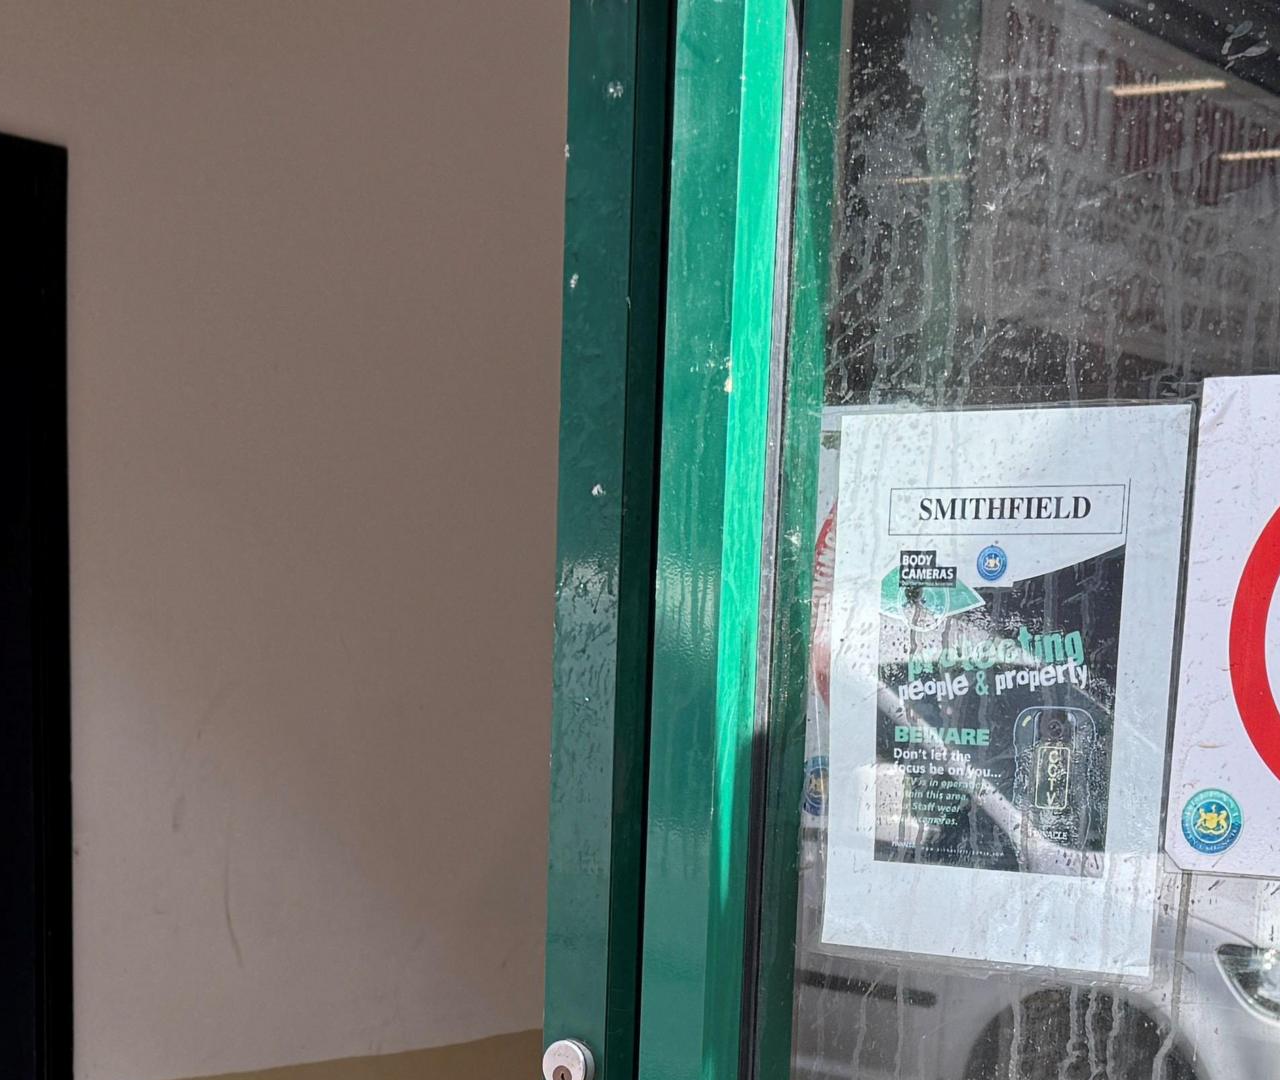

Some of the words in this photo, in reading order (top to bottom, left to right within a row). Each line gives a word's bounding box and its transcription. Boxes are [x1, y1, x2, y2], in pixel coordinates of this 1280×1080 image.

[919, 496, 1092, 521] SMITHFIELD
[902, 554, 933, 566] BODY
[901, 568, 954, 580] CAMERAS
[908, 626, 1085, 681] protecting
[898, 673, 969, 702] people
[975, 671, 989, 696] &
[995, 657, 1087, 696] property
[894, 726, 990, 746] BEWARE
[893, 748, 927, 760] Don't
[931, 749, 947, 761] let
[950, 750, 971, 762] the
[894, 760, 926, 773] focus
[929, 763, 944, 775] be
[948, 766, 963, 776] on
[929, 778, 938, 787] in
[1047, 750, 1060, 806] CCTV
[926, 790, 944, 799] this
[912, 802, 935, 812] Staff
[937, 804, 960, 813] wear
